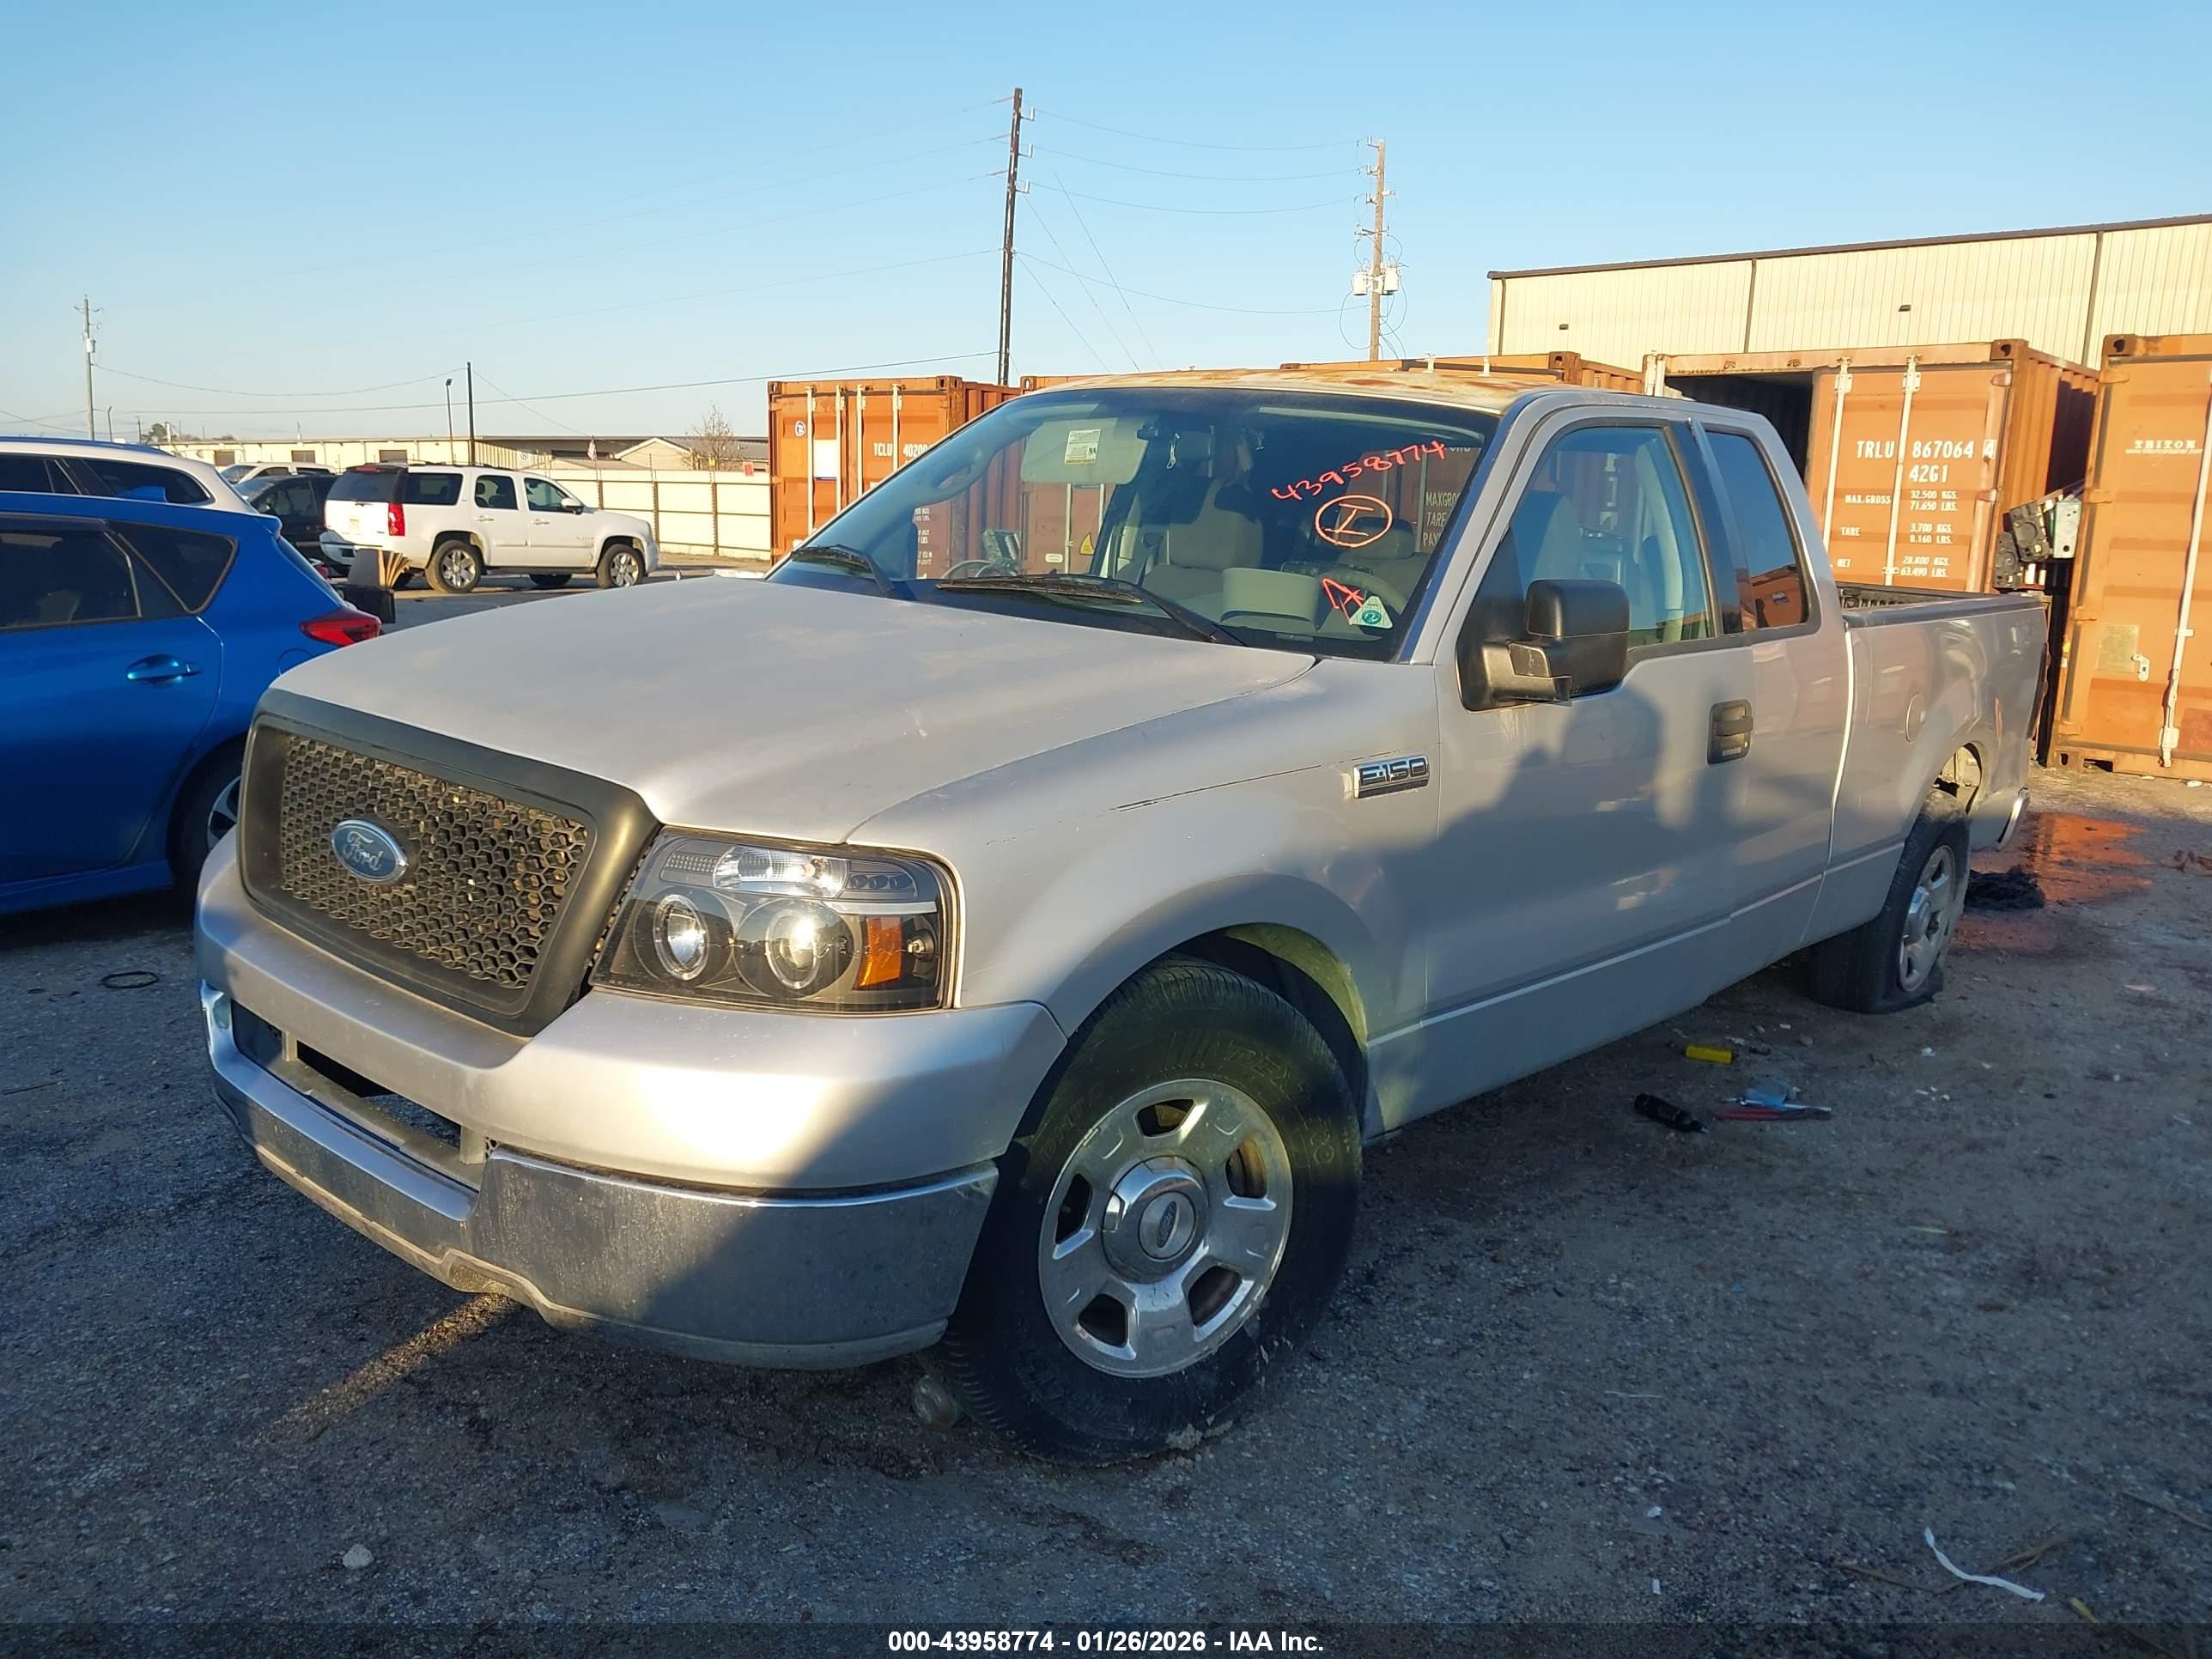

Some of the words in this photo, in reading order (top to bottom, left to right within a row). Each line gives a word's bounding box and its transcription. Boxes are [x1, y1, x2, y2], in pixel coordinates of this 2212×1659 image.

[873, 442, 893, 457] TCLU
[1856, 441, 1895, 459] TRLU
[1911, 441, 1974, 459] 867064
[1982, 439, 1997, 459] 4
[1271, 440, 1446, 501] 43958774
[1909, 465, 1948, 483] 42G1
[1910, 490, 1938, 500] 32.500
[1910, 501, 1938, 511] 71.650
[1841, 526, 1862, 537] TARE
[1422, 532, 1441, 547] PAY
[343, 830, 385, 871] Ford
